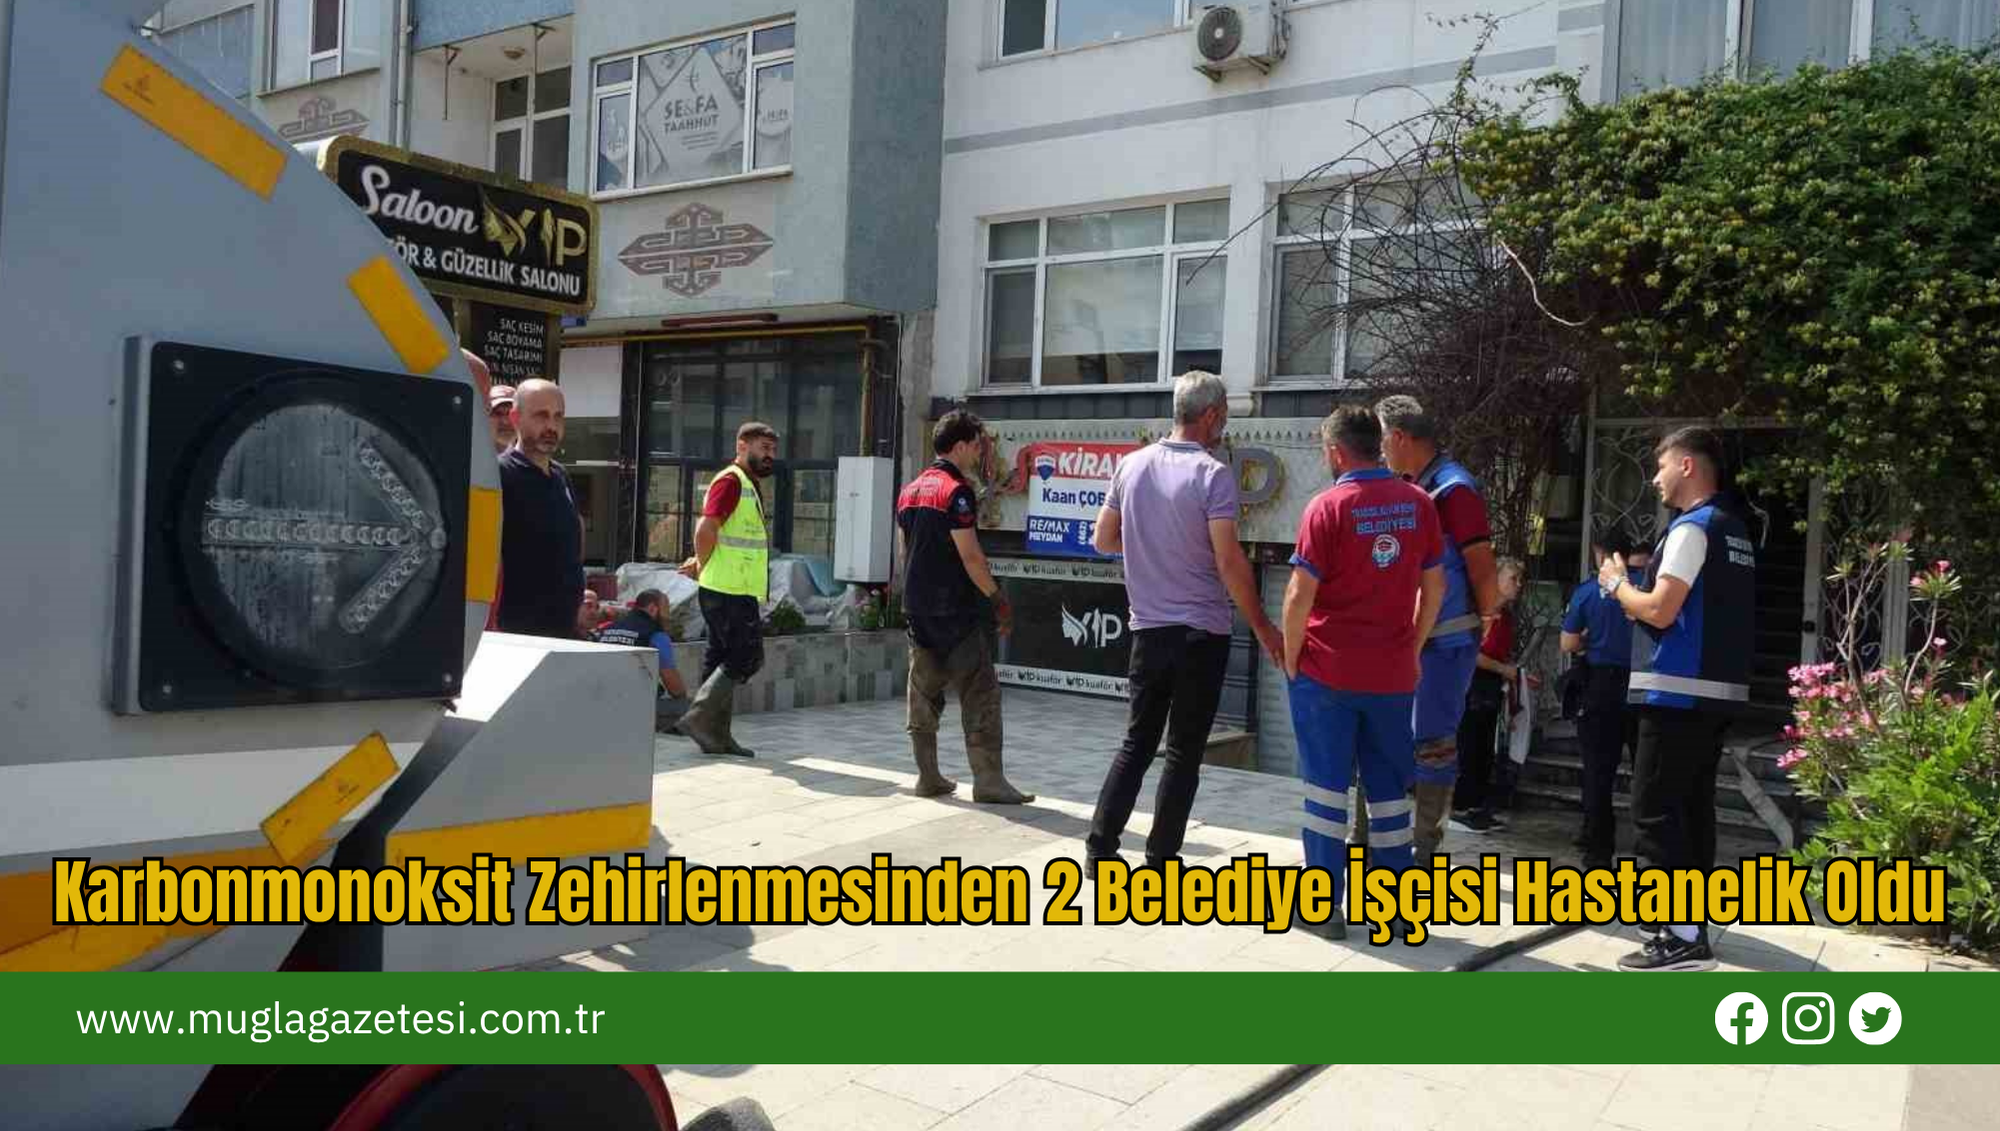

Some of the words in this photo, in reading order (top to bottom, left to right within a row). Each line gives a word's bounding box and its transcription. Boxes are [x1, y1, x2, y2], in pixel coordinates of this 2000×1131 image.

[360, 164, 479, 235] Saloon
[389, 236, 419, 267] ÖR
[422, 247, 437, 269] &
[441, 248, 515, 284] GÜZELLİK
[520, 265, 581, 297] SALONU
[1042, 488, 1076, 505] Kaan
[1028, 519, 1070, 533] RE/MAX
